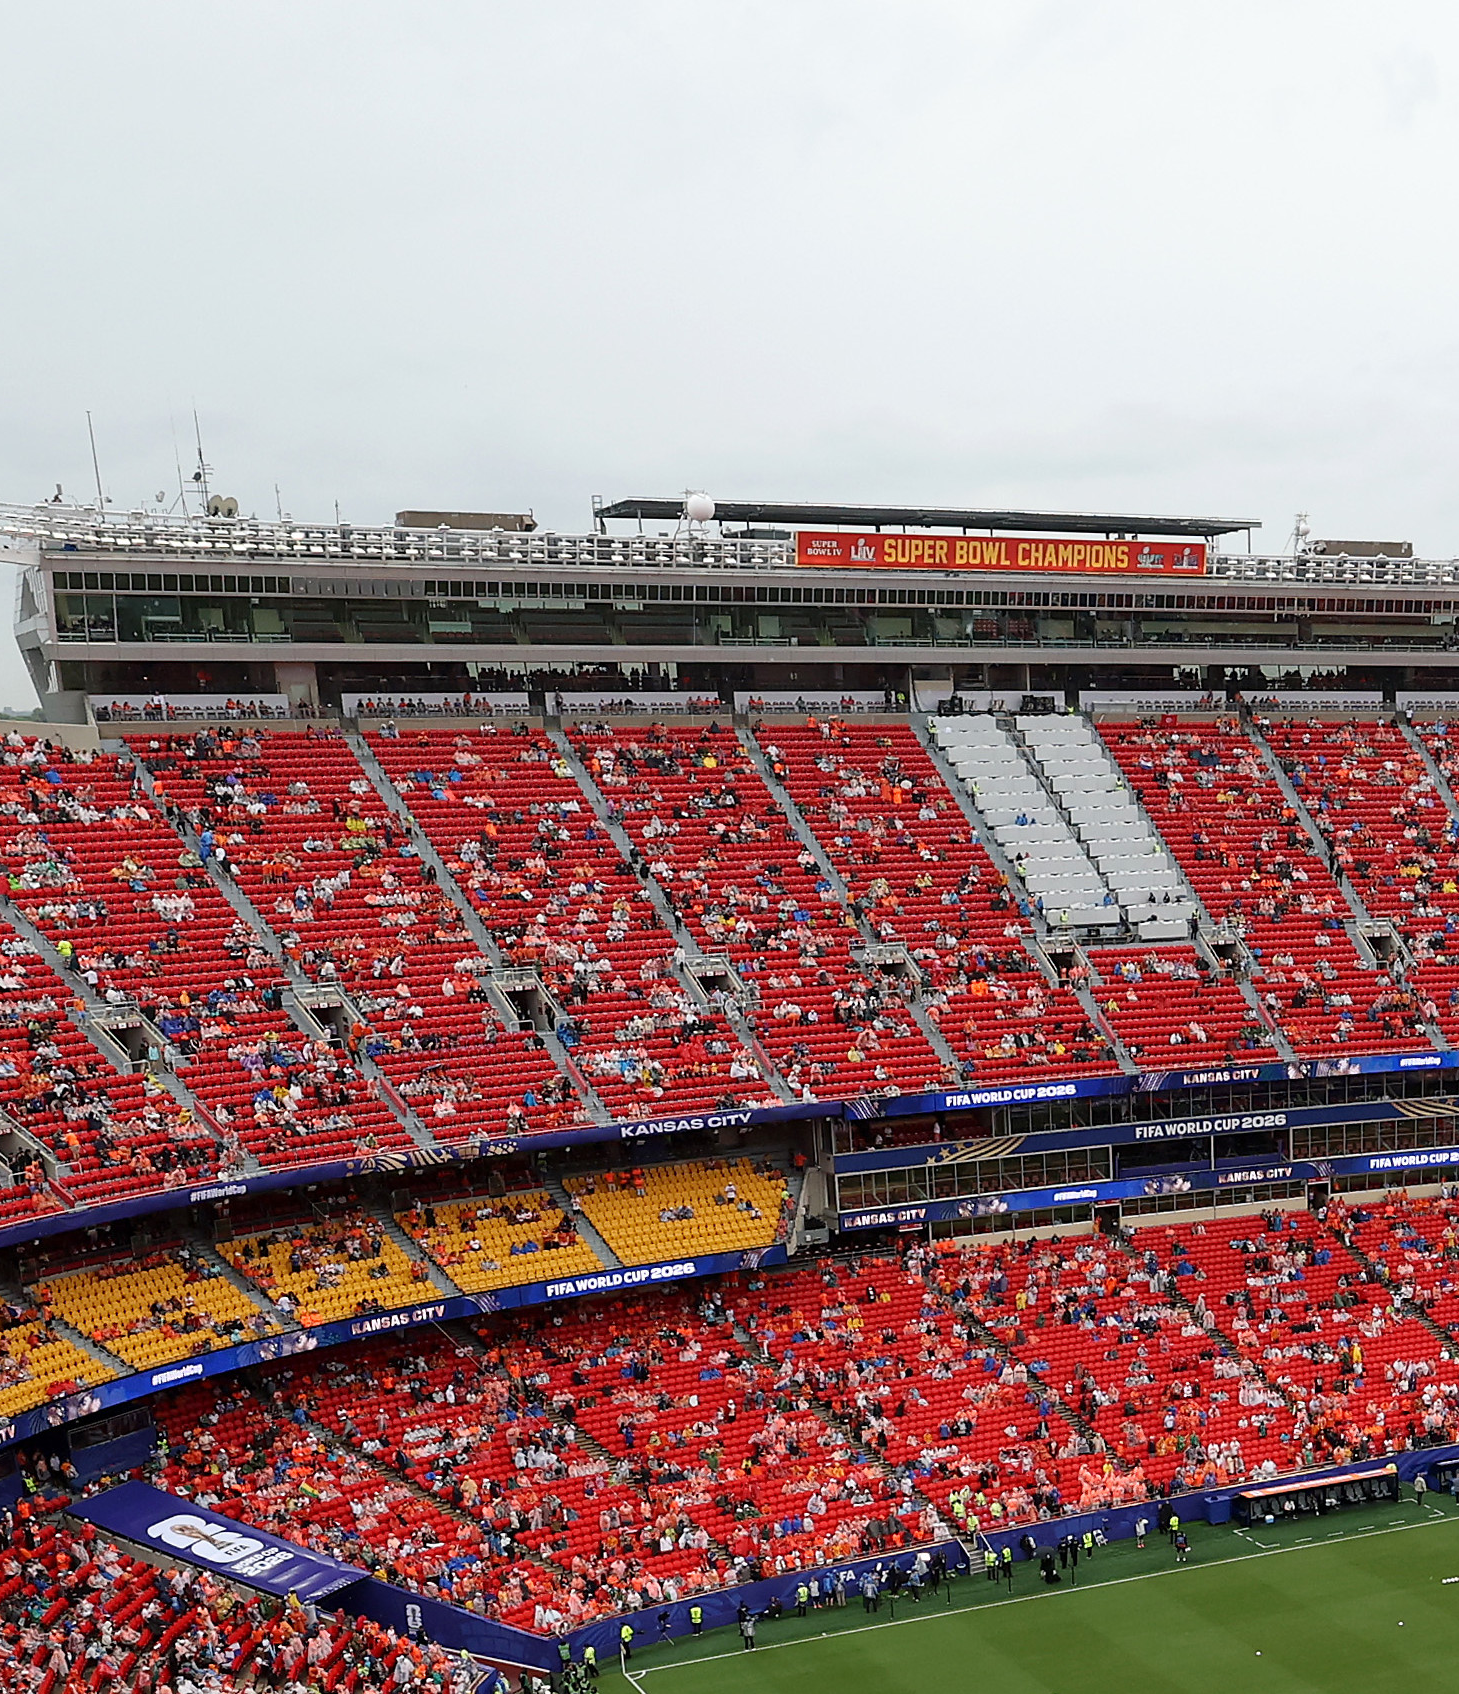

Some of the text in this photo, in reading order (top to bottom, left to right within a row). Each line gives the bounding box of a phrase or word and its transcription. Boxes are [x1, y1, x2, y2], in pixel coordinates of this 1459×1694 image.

[807, 547, 832, 556] BOWL
[811, 540, 837, 548] SUPER
[884, 539, 949, 564] SUPER
[955, 541, 1011, 565] BOWL
[1017, 543, 1129, 568] CHAMPIONS
[1183, 1069, 1259, 1085] KANSAS CITY
[945, 1084, 1076, 1106] FIFA WORLD CUP 2026
[620, 1112, 751, 1137] KANSAS CITY
[1135, 1114, 1286, 1138] FIFA WORLD CUP 2026
[1370, 1158, 1391, 1169] FIFA
[1392, 1154, 1428, 1167] WORLD
[1429, 1153, 1450, 1164] CUP
[1218, 1168, 1292, 1184] KANSAS CITY
[844, 1208, 926, 1228] KANSAS CITY
[546, 1262, 696, 1297] FIFA WORLD CUP 2026
[351, 1305, 445, 1335] KANSAS CITY
[224, 1544, 250, 1557] FIFA
[243, 1551, 295, 1577] 2026
